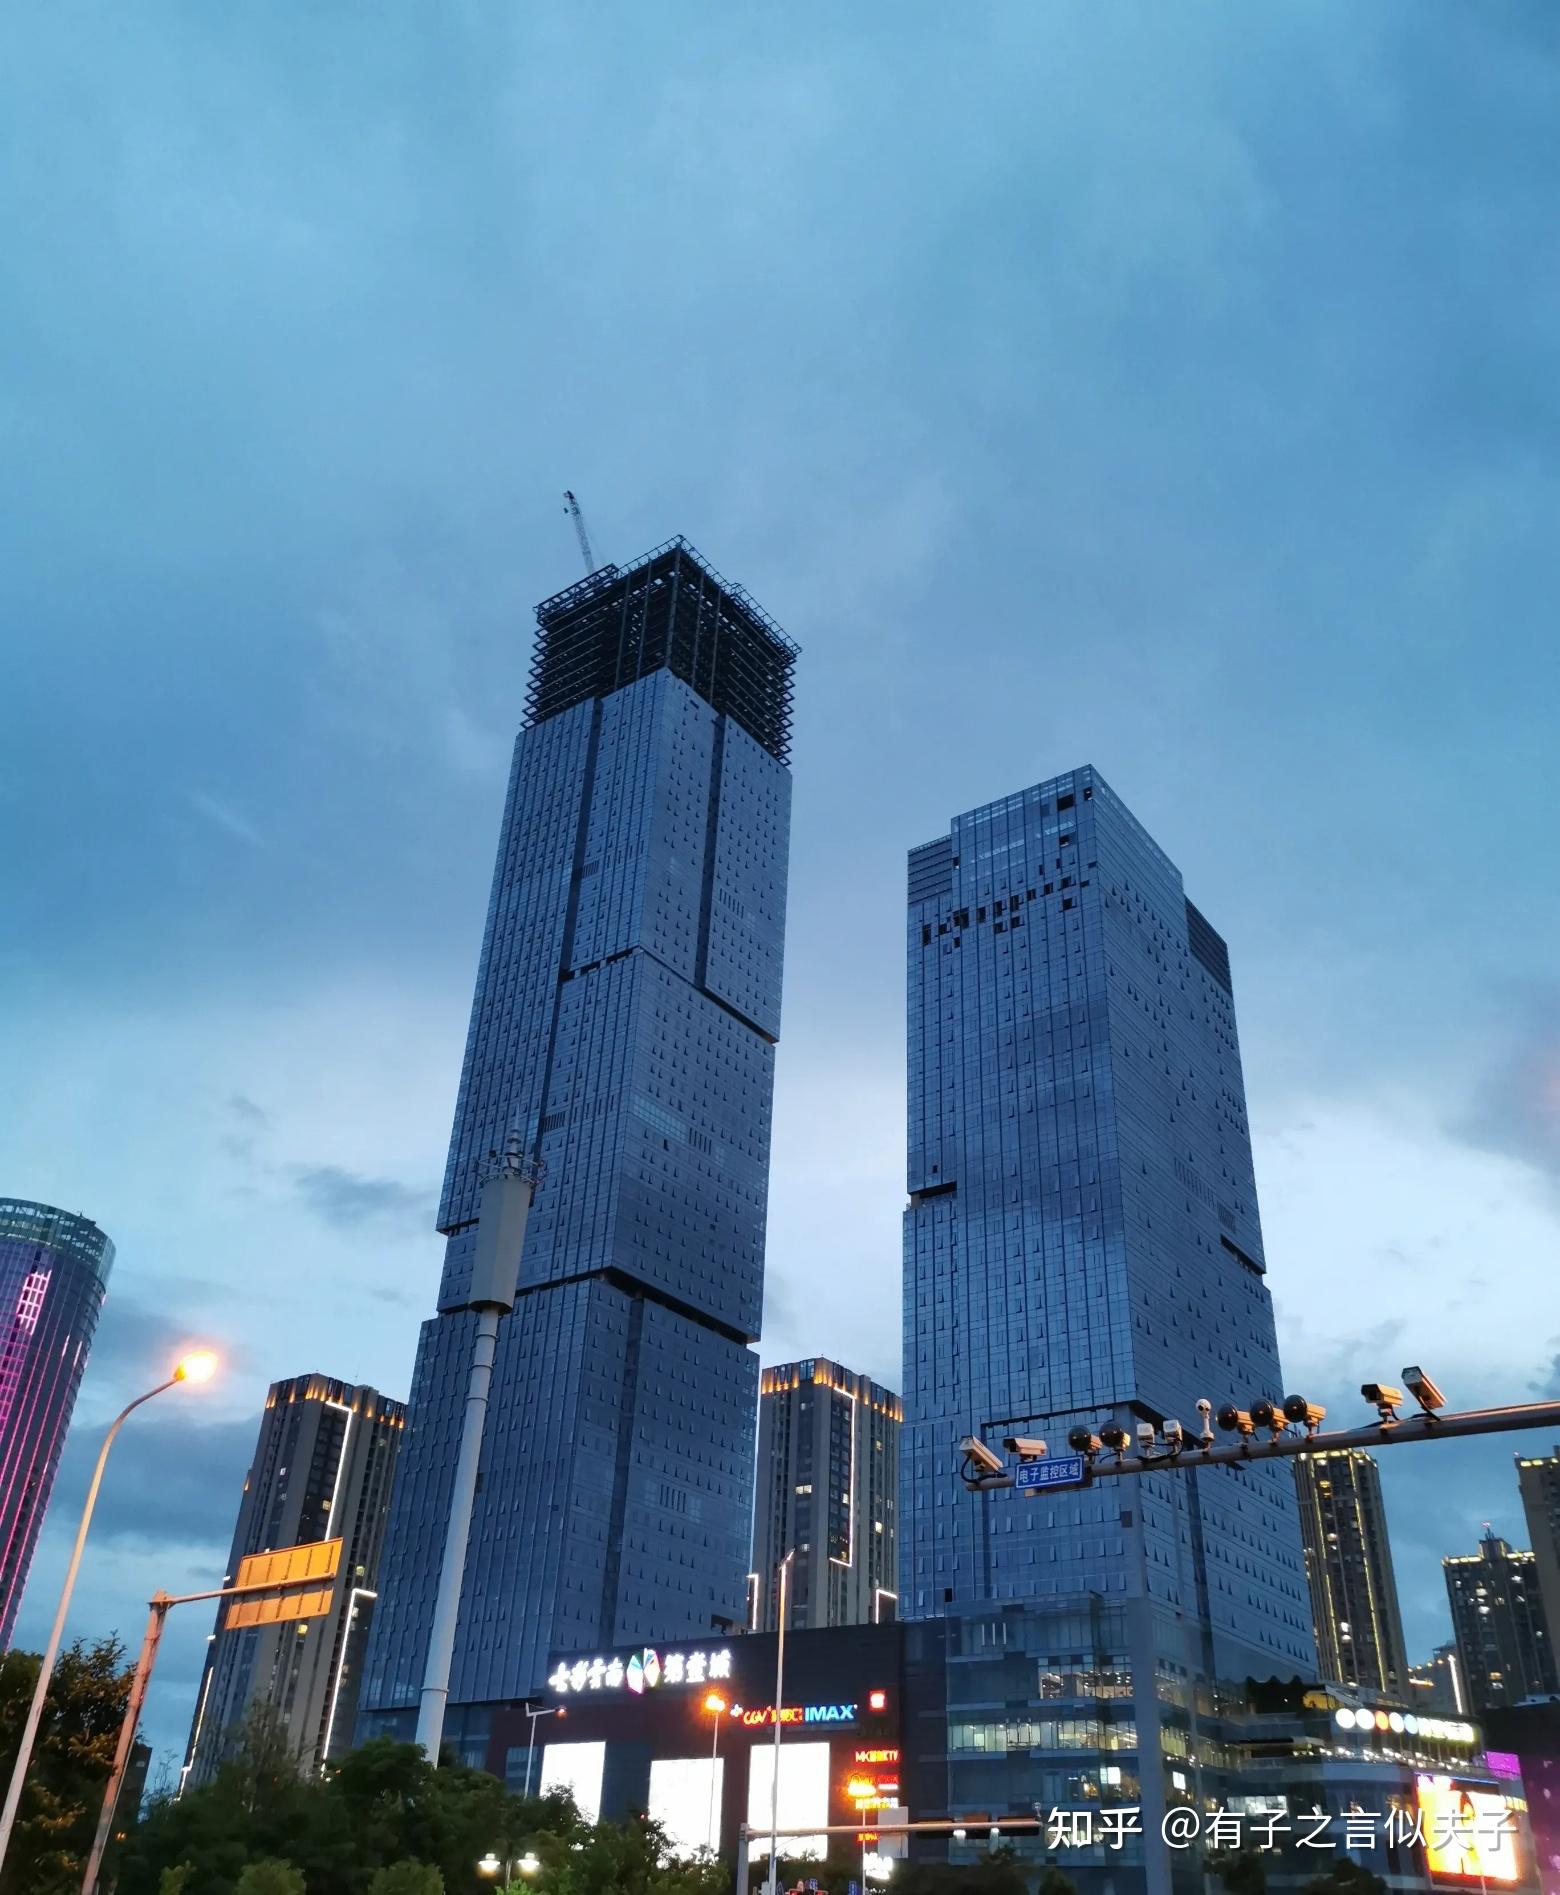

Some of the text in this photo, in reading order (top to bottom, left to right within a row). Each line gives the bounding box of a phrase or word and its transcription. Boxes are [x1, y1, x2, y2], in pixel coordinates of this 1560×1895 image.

[1020, 1462, 1079, 1483] 电子监控区域
[664, 1649, 731, 1683] 第壹城
[743, 1710, 768, 1725] CGV
[805, 1704, 854, 1721] IMAX
